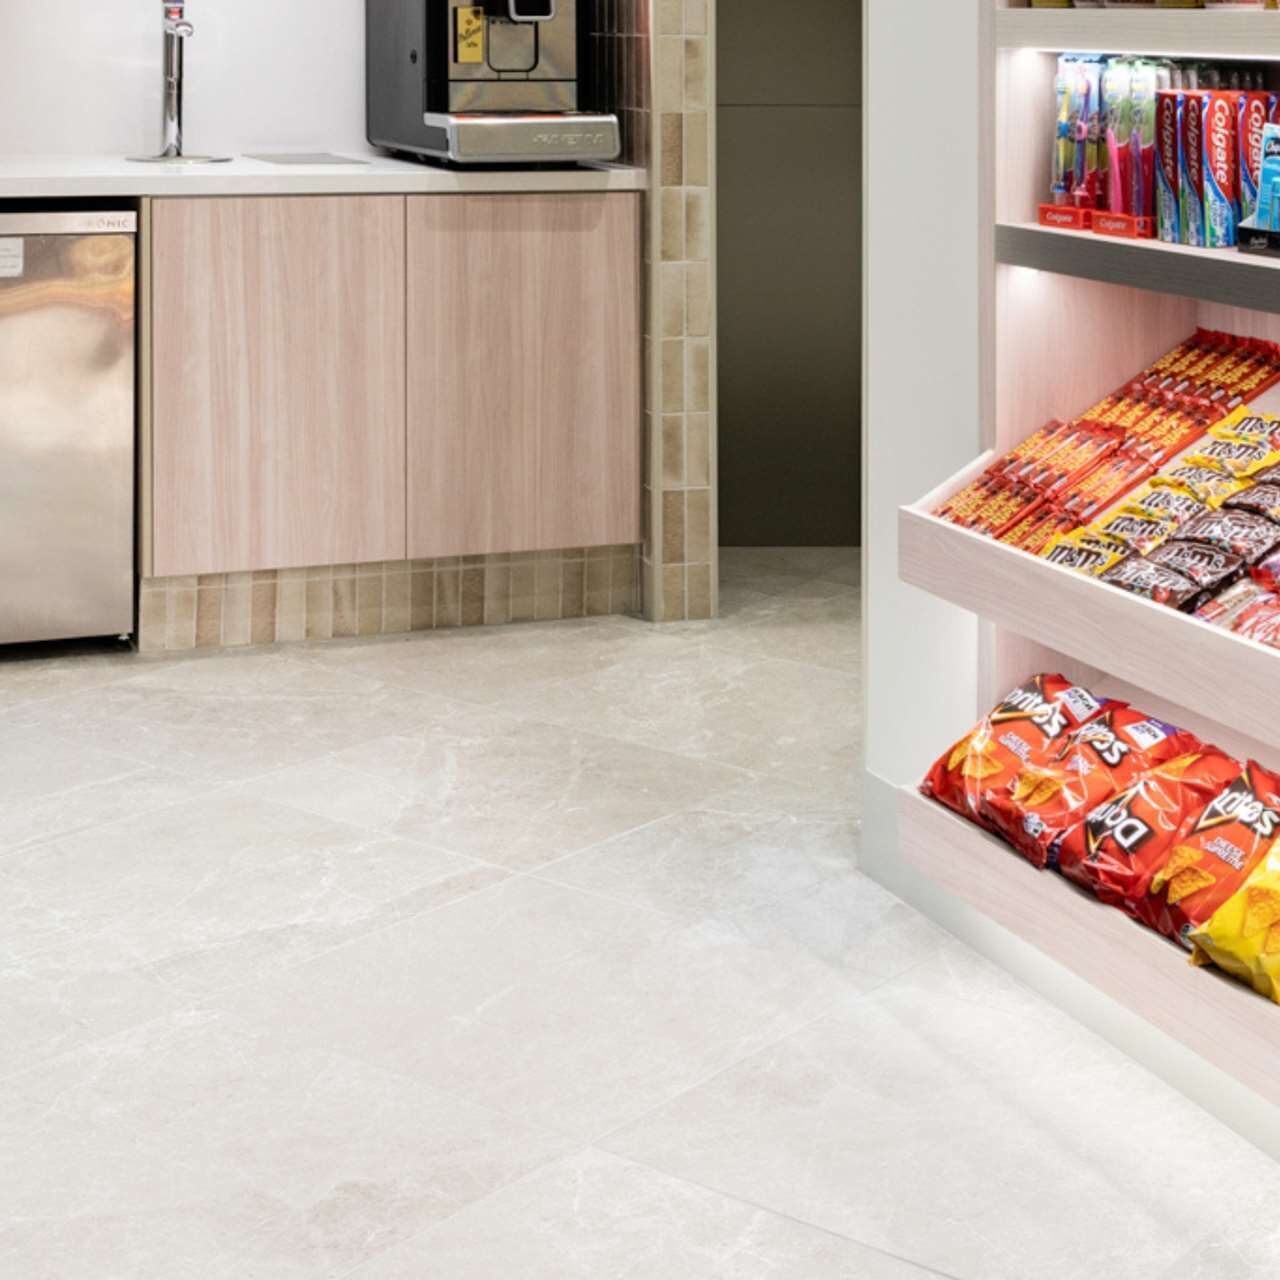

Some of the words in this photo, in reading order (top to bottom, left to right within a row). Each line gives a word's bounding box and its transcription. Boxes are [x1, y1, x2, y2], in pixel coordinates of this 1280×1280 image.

[1212, 98, 1229, 184] Colgate
[1046, 212, 1074, 224] Colgate
[1046, 544, 1108, 568] m&m's
